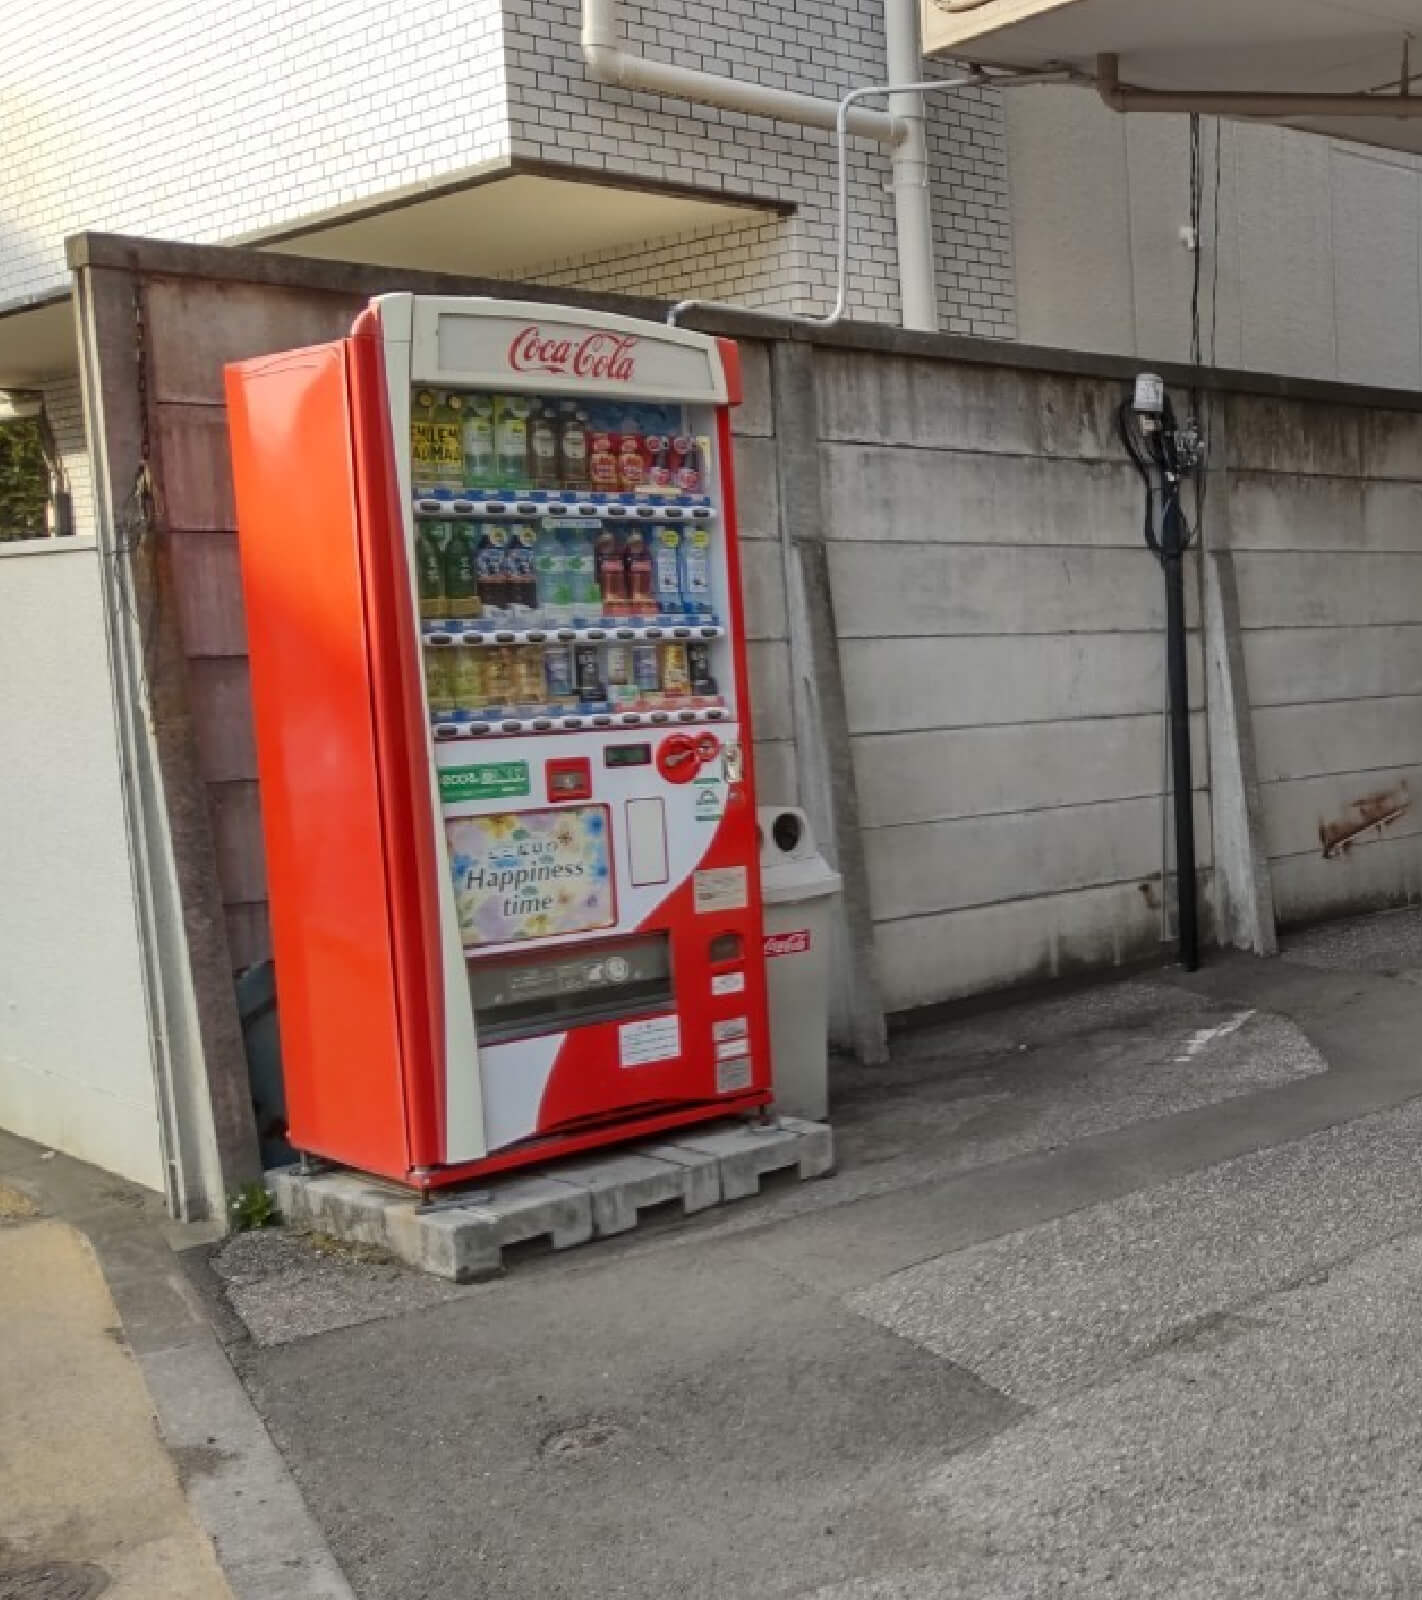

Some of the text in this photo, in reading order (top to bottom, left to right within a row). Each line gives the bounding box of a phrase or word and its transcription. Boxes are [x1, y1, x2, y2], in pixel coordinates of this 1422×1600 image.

[508, 326, 638, 382] Coca-Cola
[466, 860, 584, 892] Happiness
[503, 894, 553, 917] time
